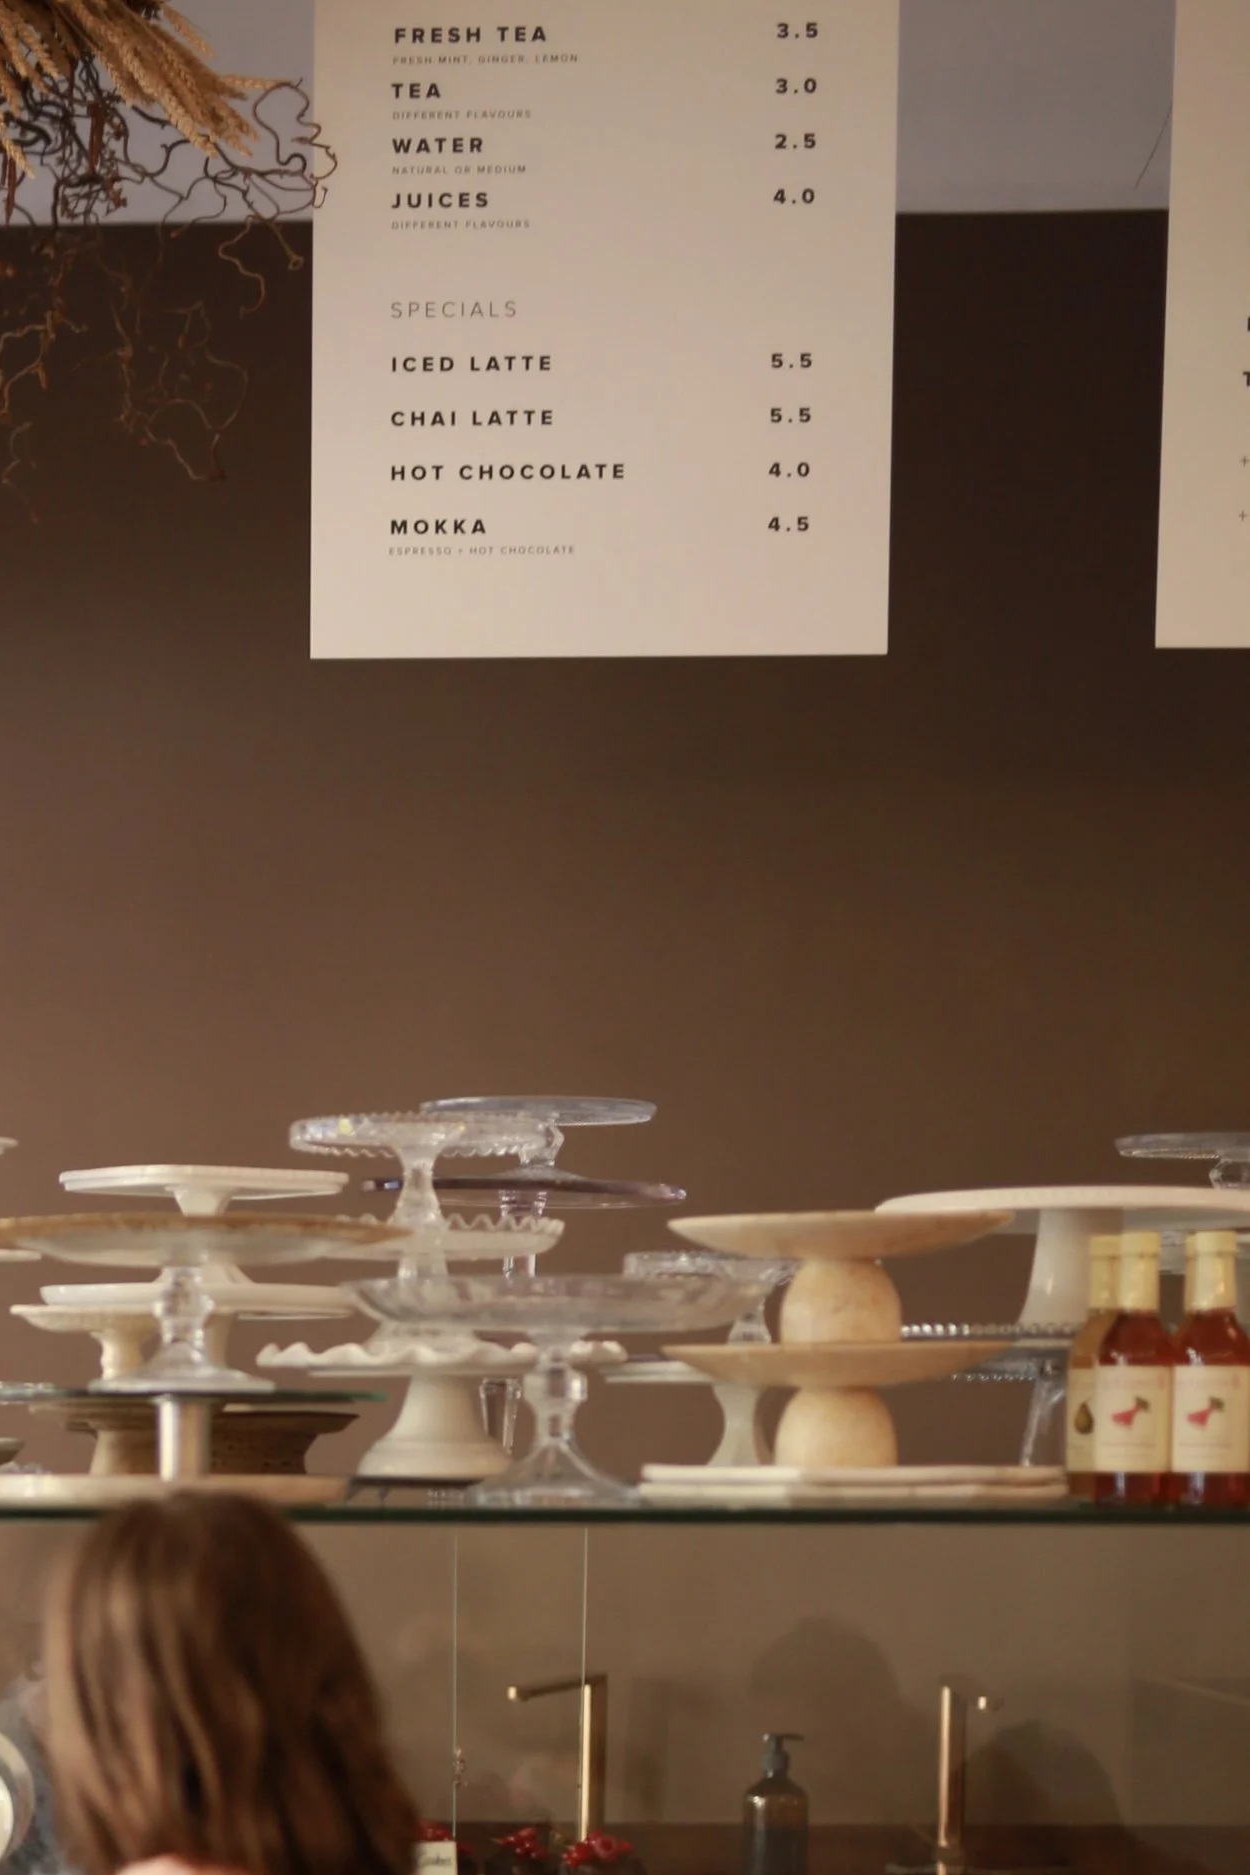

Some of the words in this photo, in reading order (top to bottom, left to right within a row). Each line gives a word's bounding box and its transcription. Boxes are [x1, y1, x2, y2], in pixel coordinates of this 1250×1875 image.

[394, 26, 481, 44] FRESH
[496, 25, 547, 43] TEA
[776, 21, 819, 39] 3.5
[392, 55, 433, 65] FRESH
[534, 52, 579, 64] LEMON
[390, 82, 441, 100] TEA
[775, 77, 817, 95] 3.0
[392, 109, 461, 121] DIFFERENT
[466, 109, 532, 120] FLAVOURS
[391, 137, 483, 155] WATER
[774, 132, 817, 150] 2.5
[391, 165, 449, 176] NATURAL
[453, 165, 471, 175] OR
[476, 164, 527, 175] MEDIUM
[391, 191, 489, 209] JUICES
[773, 187, 815, 205] 4.0
[391, 219, 460, 230] DIFFERENT
[464, 218, 531, 229] FLAVOURS
[390, 300, 517, 319] SPECIALS
[391, 356, 455, 373] ICED
[470, 355, 551, 372] LATTE
[771, 352, 813, 369] 5.5
[390, 410, 456, 427] CHAI
[472, 409, 553, 427] LATTE
[770, 407, 812, 424] 5.5
[390, 465, 444, 481] HOT
[458, 463, 624, 481] CHOCOLATE
[768, 461, 811, 478] 4.0
[390, 518, 486, 535] MOKKA
[767, 516, 810, 532] 4.5
[388, 546, 452, 557] ESPRESSO
[468, 545, 494, 556] HOT
[499, 544, 576, 556] CHOCOLATE
